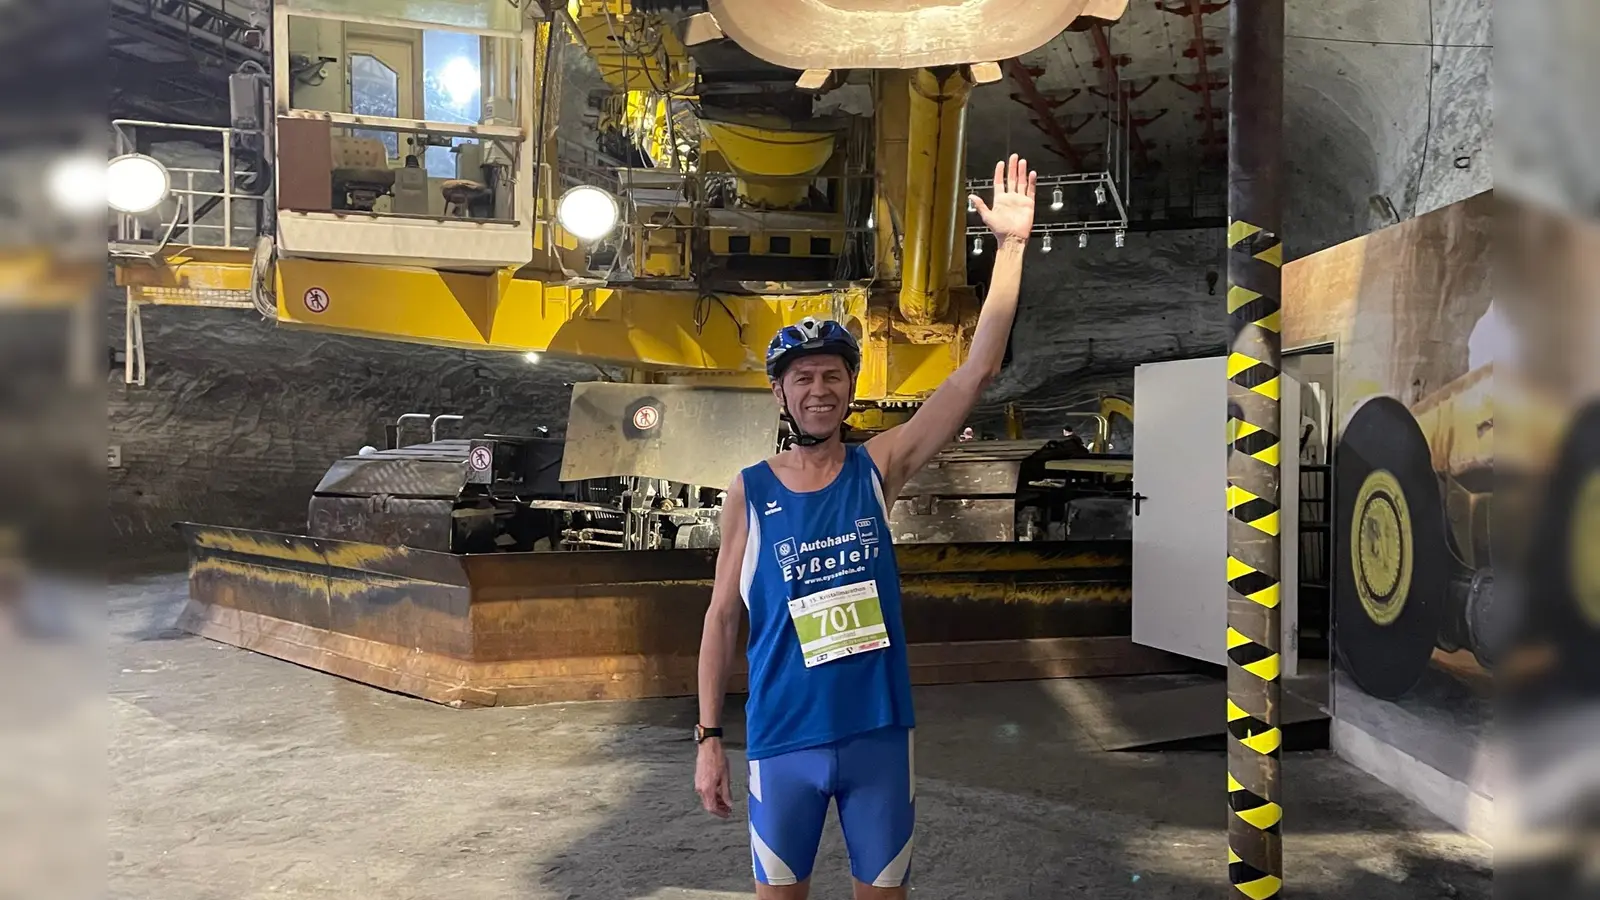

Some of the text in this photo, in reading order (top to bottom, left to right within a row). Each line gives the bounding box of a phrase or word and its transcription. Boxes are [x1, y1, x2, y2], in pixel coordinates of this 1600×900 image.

[799, 532, 857, 554] Autohaus
[804, 566, 866, 585] www.eysselein.de
[819, 586, 866, 600] Kristallmarathon
[812, 602, 861, 637] 701
